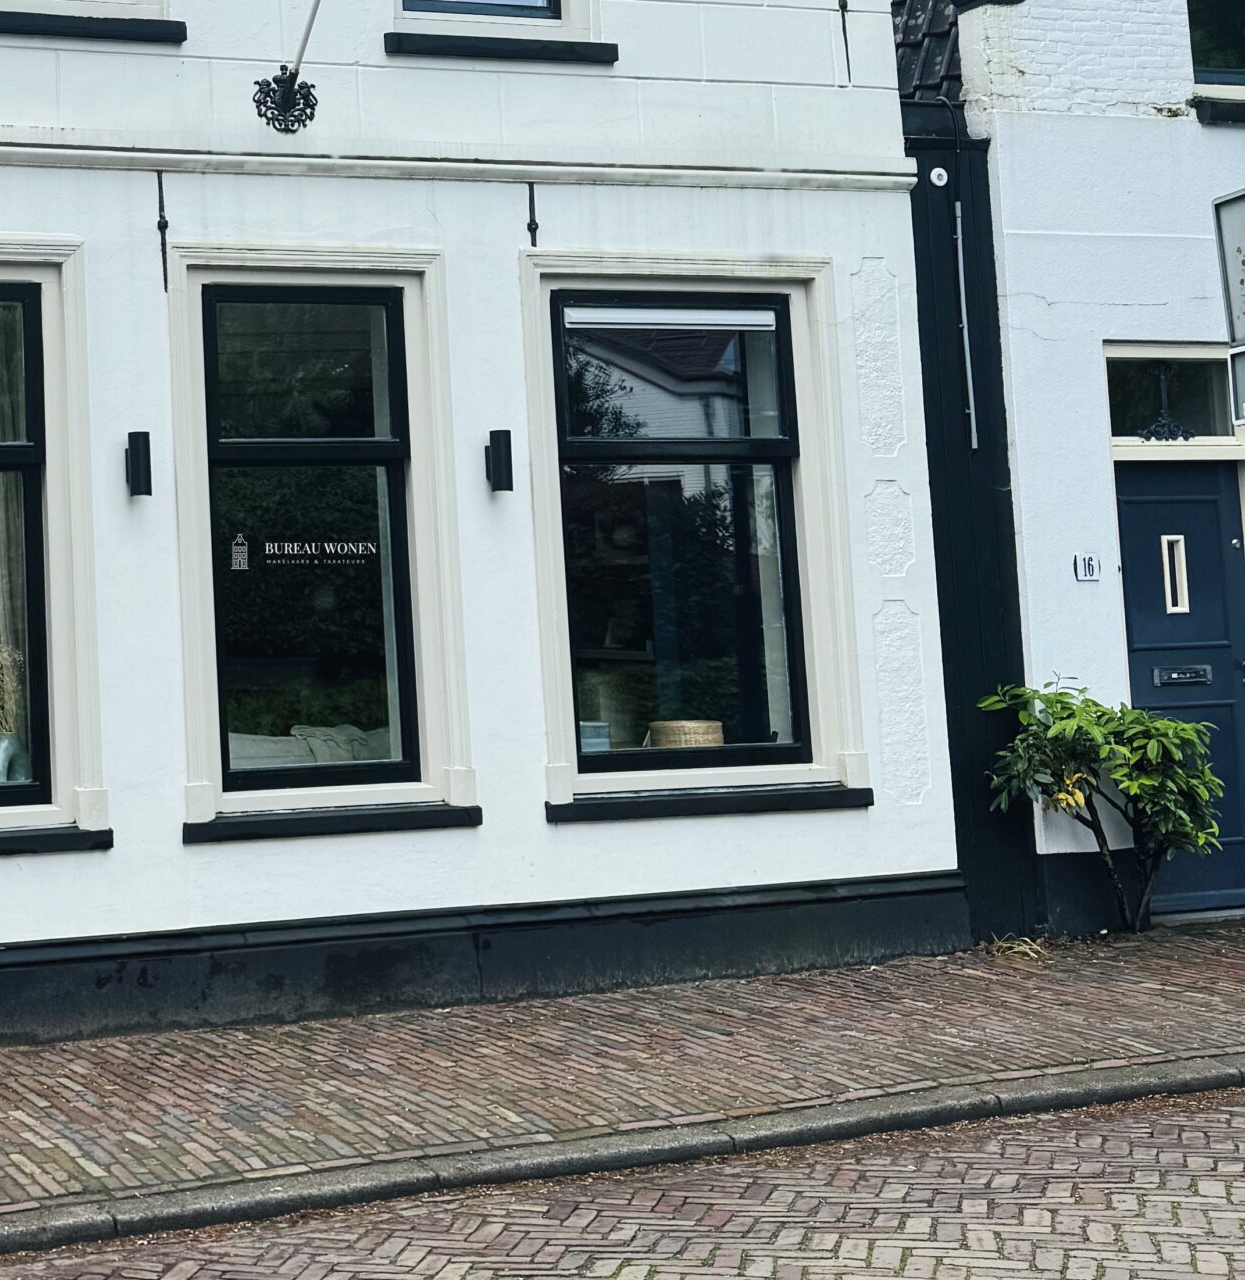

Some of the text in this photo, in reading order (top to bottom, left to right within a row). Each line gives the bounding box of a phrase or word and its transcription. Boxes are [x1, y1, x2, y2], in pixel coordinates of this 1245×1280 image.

[265, 542, 377, 554] BUREAU WONEN
[1083, 556, 1095, 577] 16
